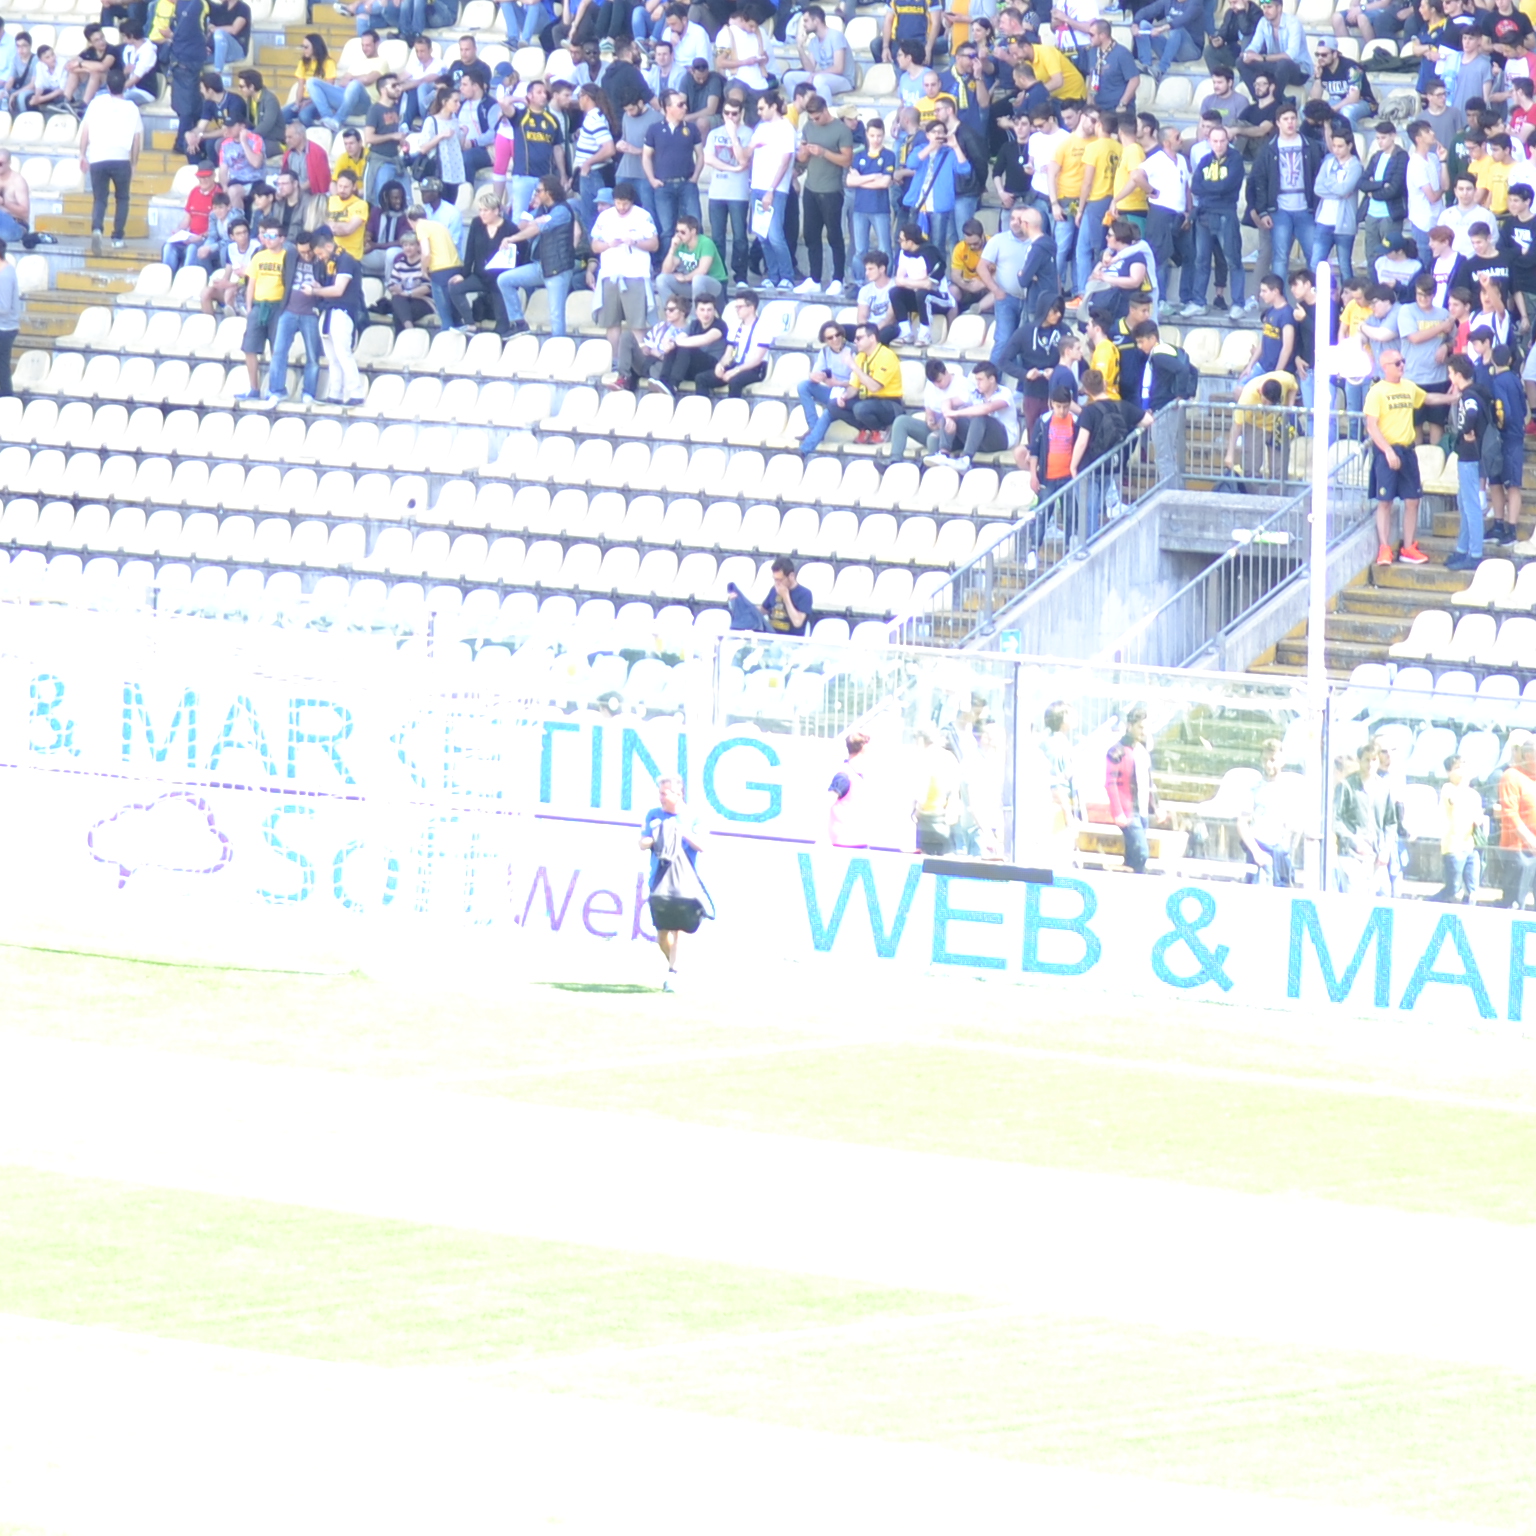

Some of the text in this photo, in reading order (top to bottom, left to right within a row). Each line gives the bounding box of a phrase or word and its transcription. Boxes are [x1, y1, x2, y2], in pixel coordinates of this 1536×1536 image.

[24, 672, 84, 758] &
[797, 852, 1103, 976] WEB
[1150, 887, 1235, 992] &
